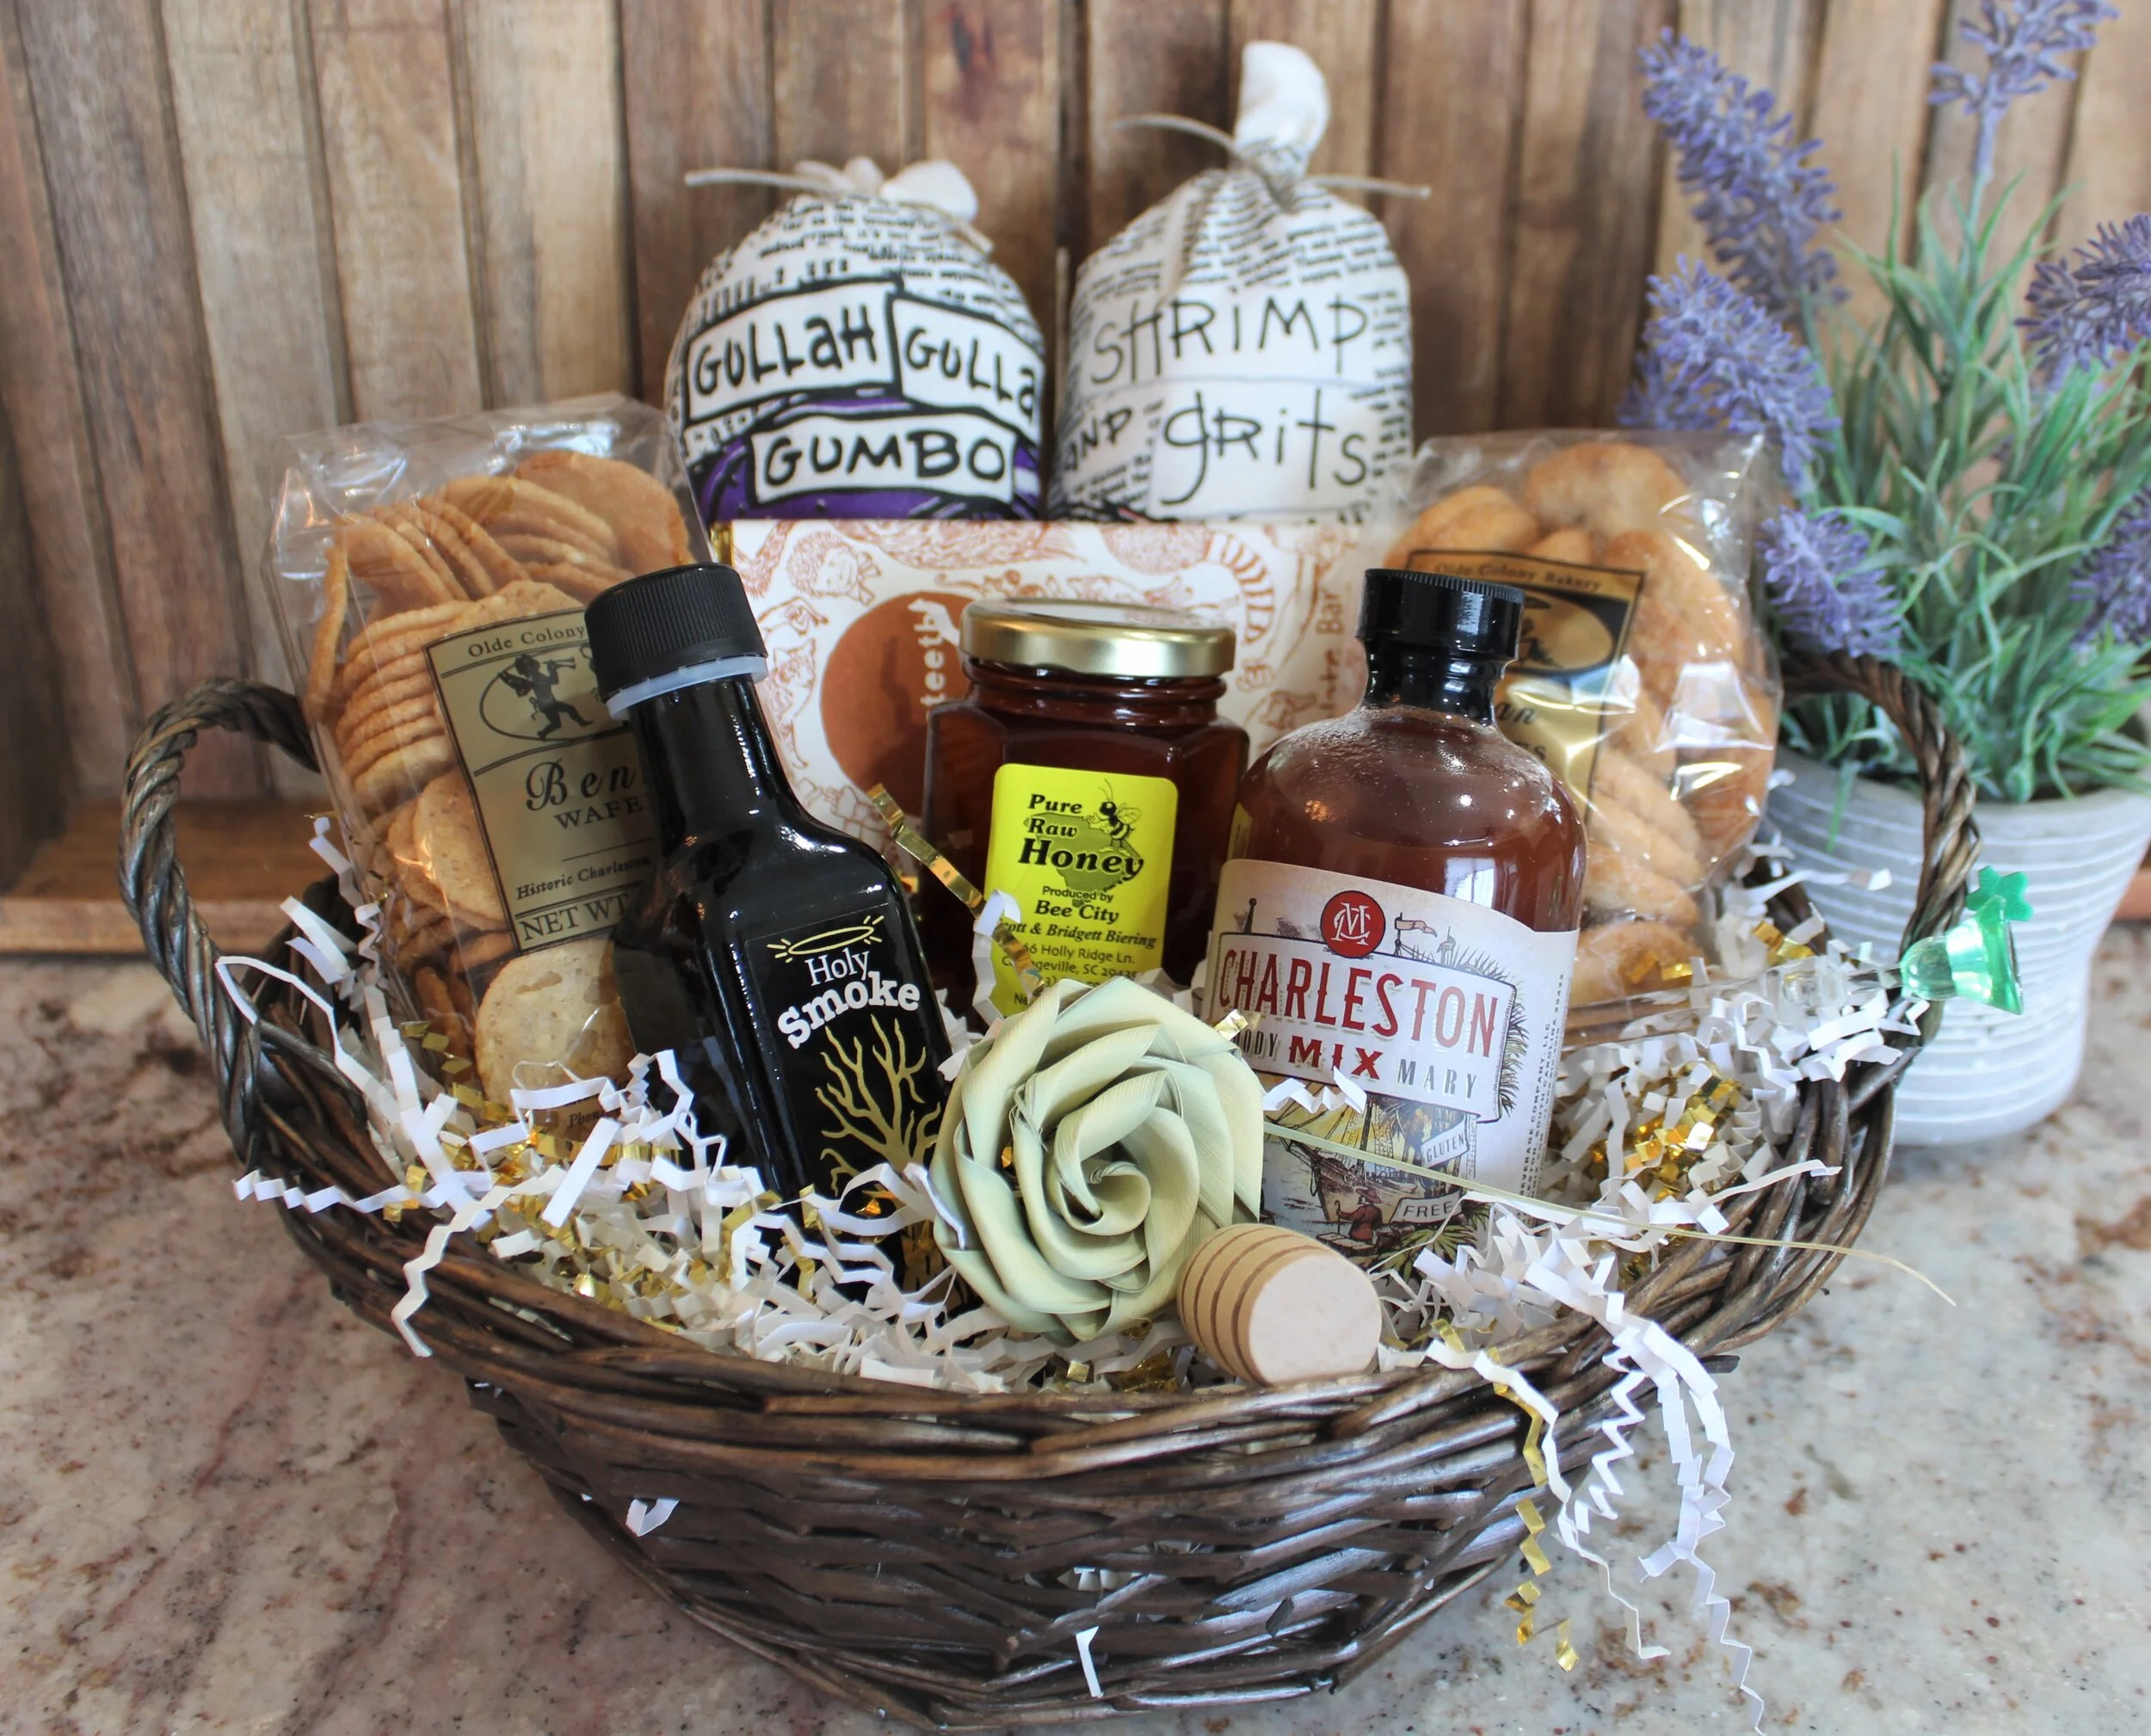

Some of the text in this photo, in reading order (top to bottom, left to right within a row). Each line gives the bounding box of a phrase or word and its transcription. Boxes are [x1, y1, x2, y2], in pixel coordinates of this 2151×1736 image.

[763, 428, 1007, 488] GUMBO
[467, 625, 585, 658] Olde Colony
[525, 760, 637, 812] Ben
[553, 795, 644, 830] WAFE
[1027, 793, 1083, 815] Pure
[1027, 817, 1078, 838] Raw
[1017, 838, 1145, 882] Honey
[516, 873, 574, 901] Historic
[1042, 885, 1114, 903] Produced by
[518, 891, 630, 942] NET WT
[1034, 899, 1119, 925] Bee City
[1001, 920, 1157, 950] cott & Bridgett Biering
[804, 947, 870, 987] Holy
[1041, 944, 1076, 960] Holly
[1078, 948, 1113, 964] Ridge
[1116, 952, 1136, 965] Ln.
[1083, 964, 1099, 976] SC
[777, 970, 921, 1050] Smoke
[1218, 948, 1500, 1059] CHARLESTON
[1542, 1023, 1550, 1048] LLC
[1288, 1034, 1384, 1080] MIX
[1397, 1058, 1478, 1099] MARY
[568, 1109, 601, 1128] Phon
[1426, 1133, 1464, 1164] GLUTEN
[1402, 1200, 1453, 1218] FREE
